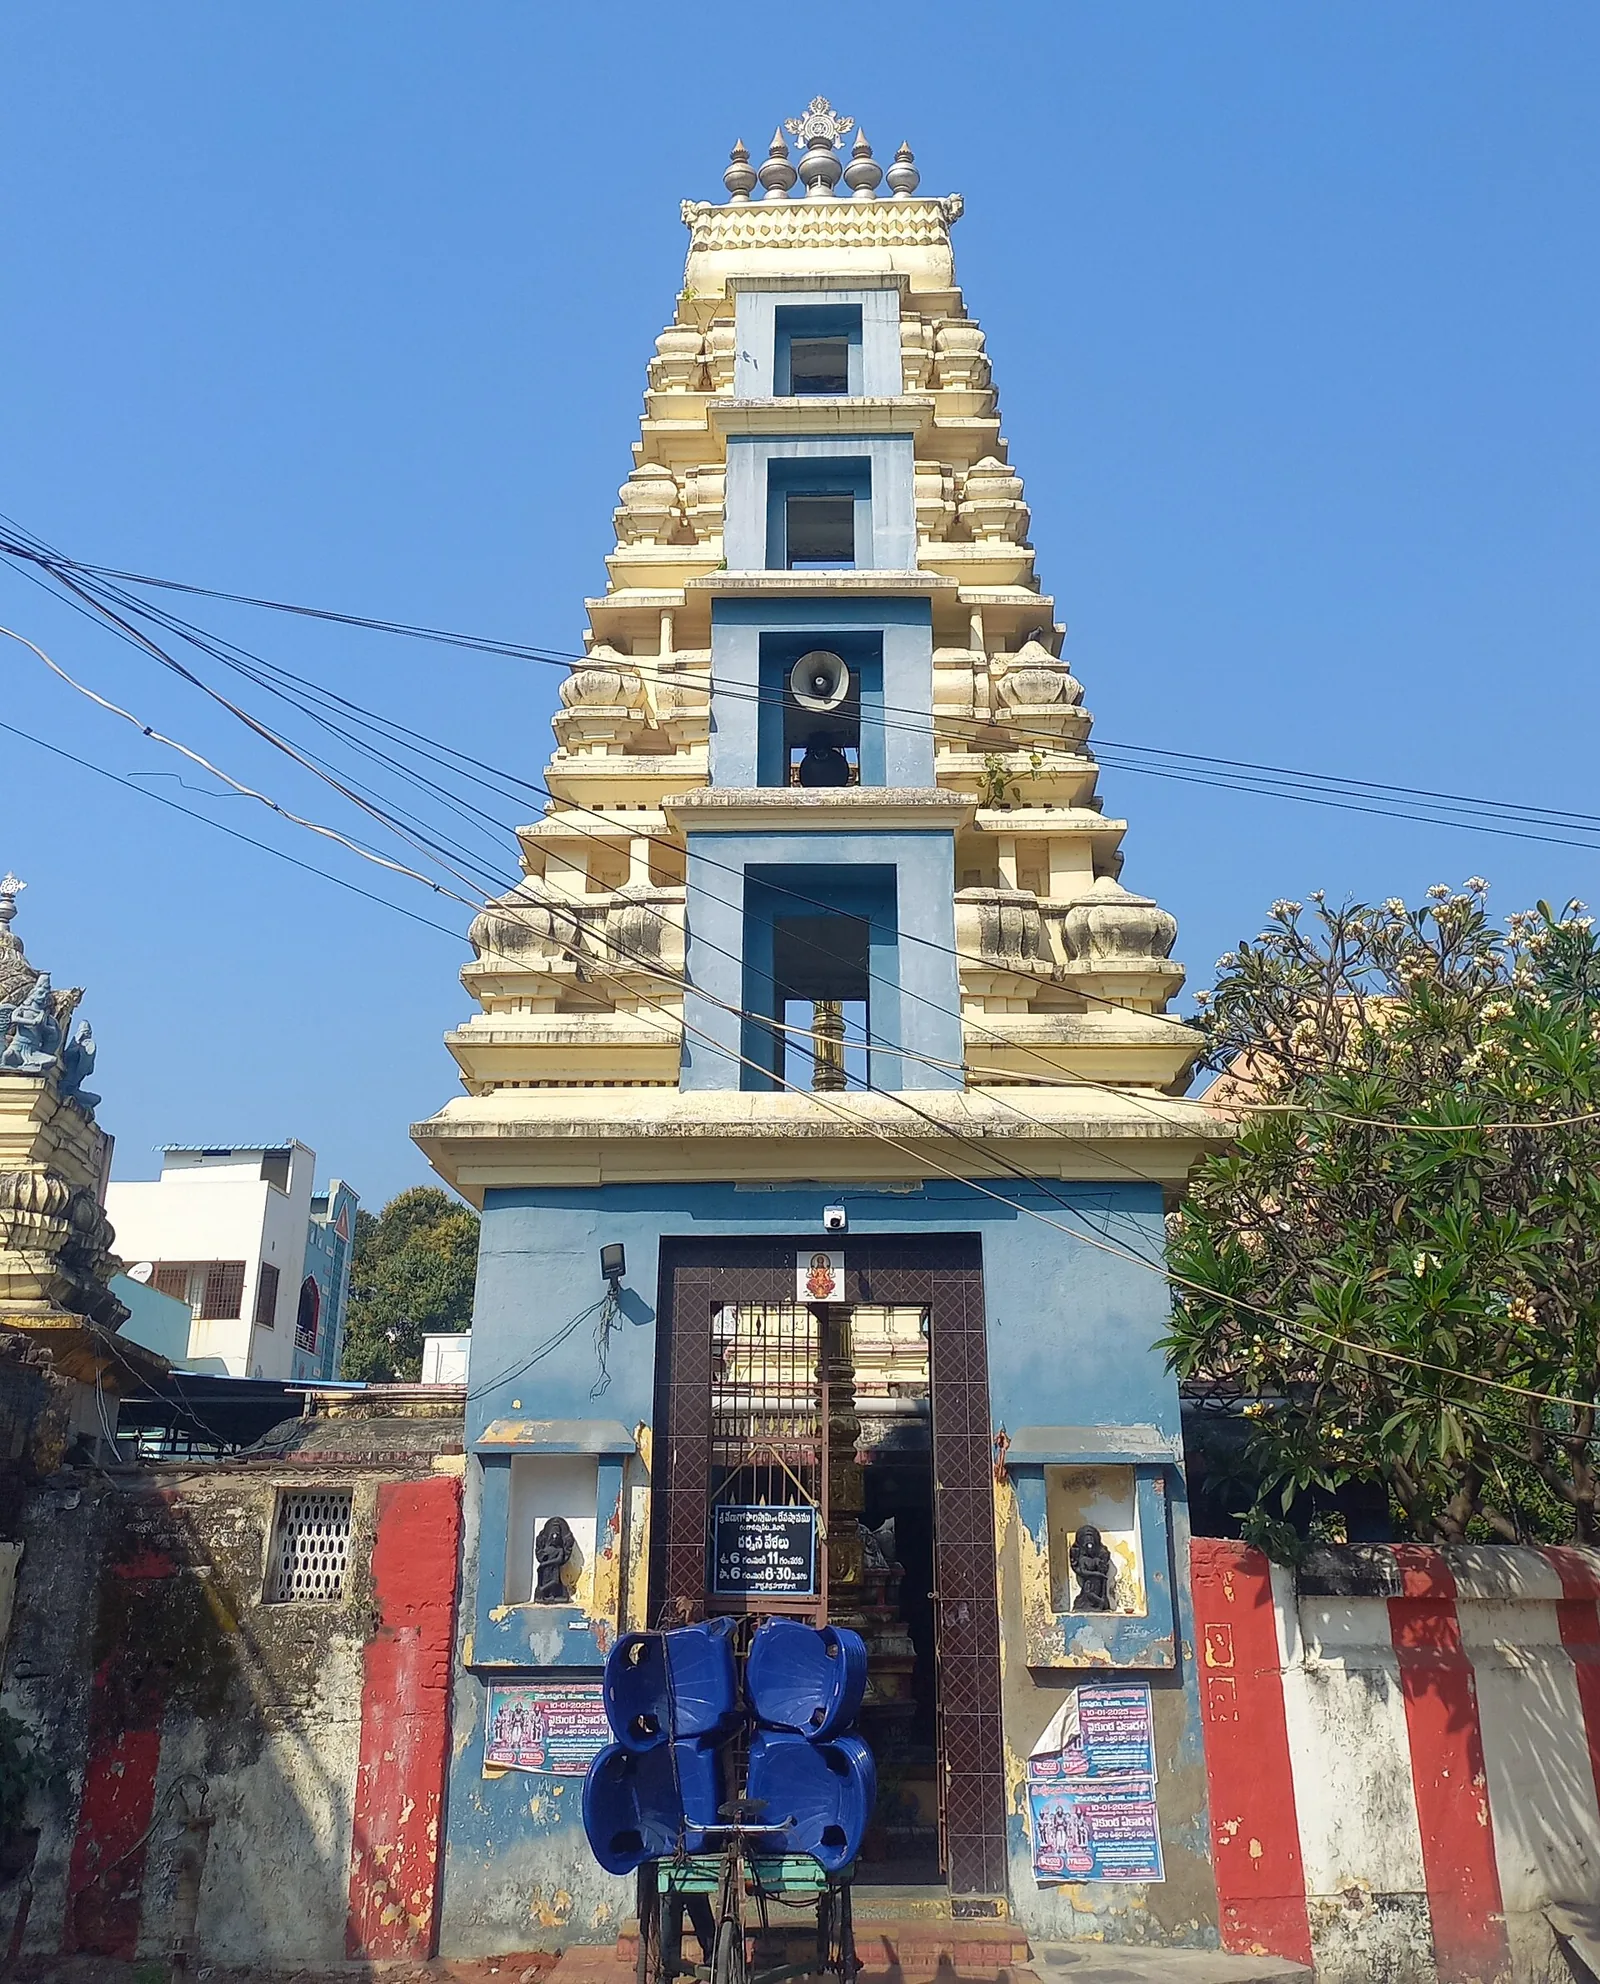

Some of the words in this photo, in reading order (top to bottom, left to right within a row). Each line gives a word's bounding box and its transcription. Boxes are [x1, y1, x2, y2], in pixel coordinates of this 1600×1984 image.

[738, 1535, 763, 1551] దర్శన
[764, 1533, 790, 1550] వేళలు
[730, 1552, 740, 1564] 6
[767, 1551, 778, 1565] 11
[730, 1567, 741, 1579] 6
[1087, 1708, 1129, 1716] 10-01-2025
